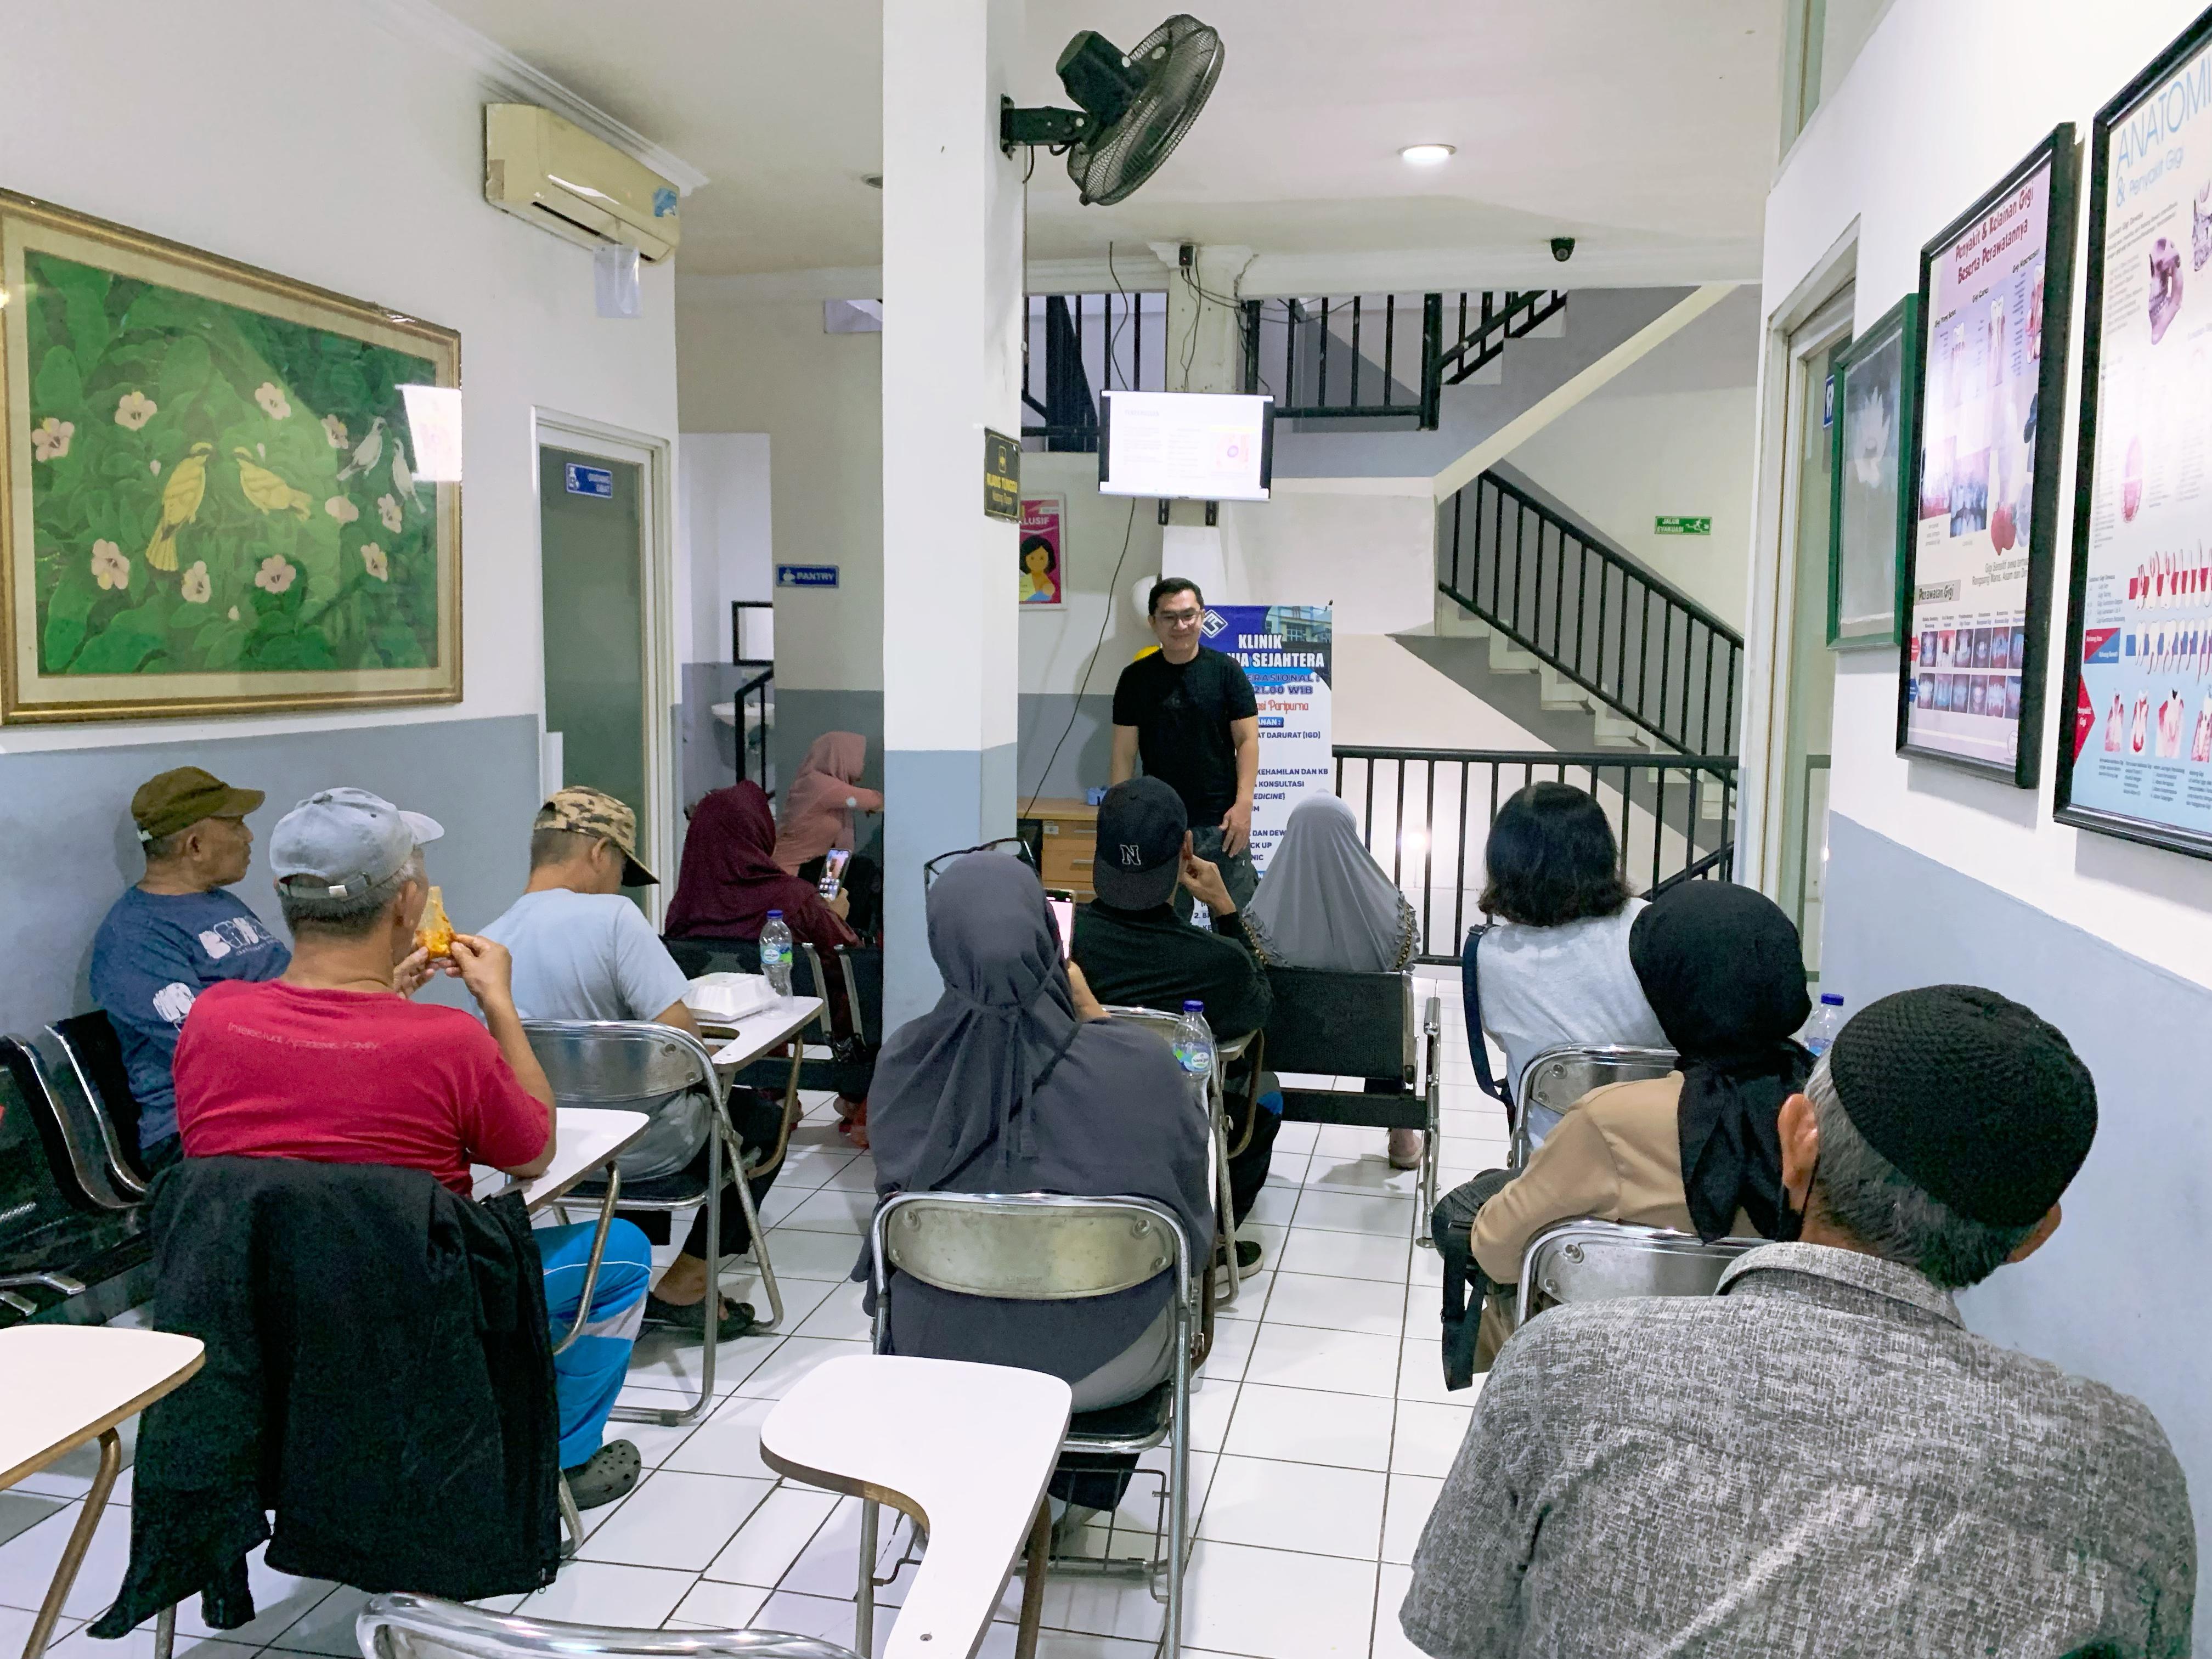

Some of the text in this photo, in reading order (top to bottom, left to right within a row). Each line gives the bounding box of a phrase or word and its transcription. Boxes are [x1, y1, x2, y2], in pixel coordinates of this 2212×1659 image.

[2116, 55, 2211, 178] ANATOMI
[1955, 180, 2034, 262] Penyakit & Kelainan Gigi
[1958, 218, 2028, 285] Beserta Perawatannya
[1022, 516, 1049, 525] LUSIF
[797, 572, 833, 580] PANTRY
[1918, 583, 1955, 600] Perawatan Gigi
[1238, 634, 1283, 649] KLINIK
[1251, 652, 1325, 668] SEJAHTERA
[1246, 674, 1313, 682] ERASIONAL
[1254, 685, 1313, 694] 21.00 WIB
[1256, 699, 1308, 714] asi Paripurna
[1303, 731, 1321, 739] (IGD)
[1253, 792, 1285, 800] EDICINE)
[1120, 844, 1141, 865] N
